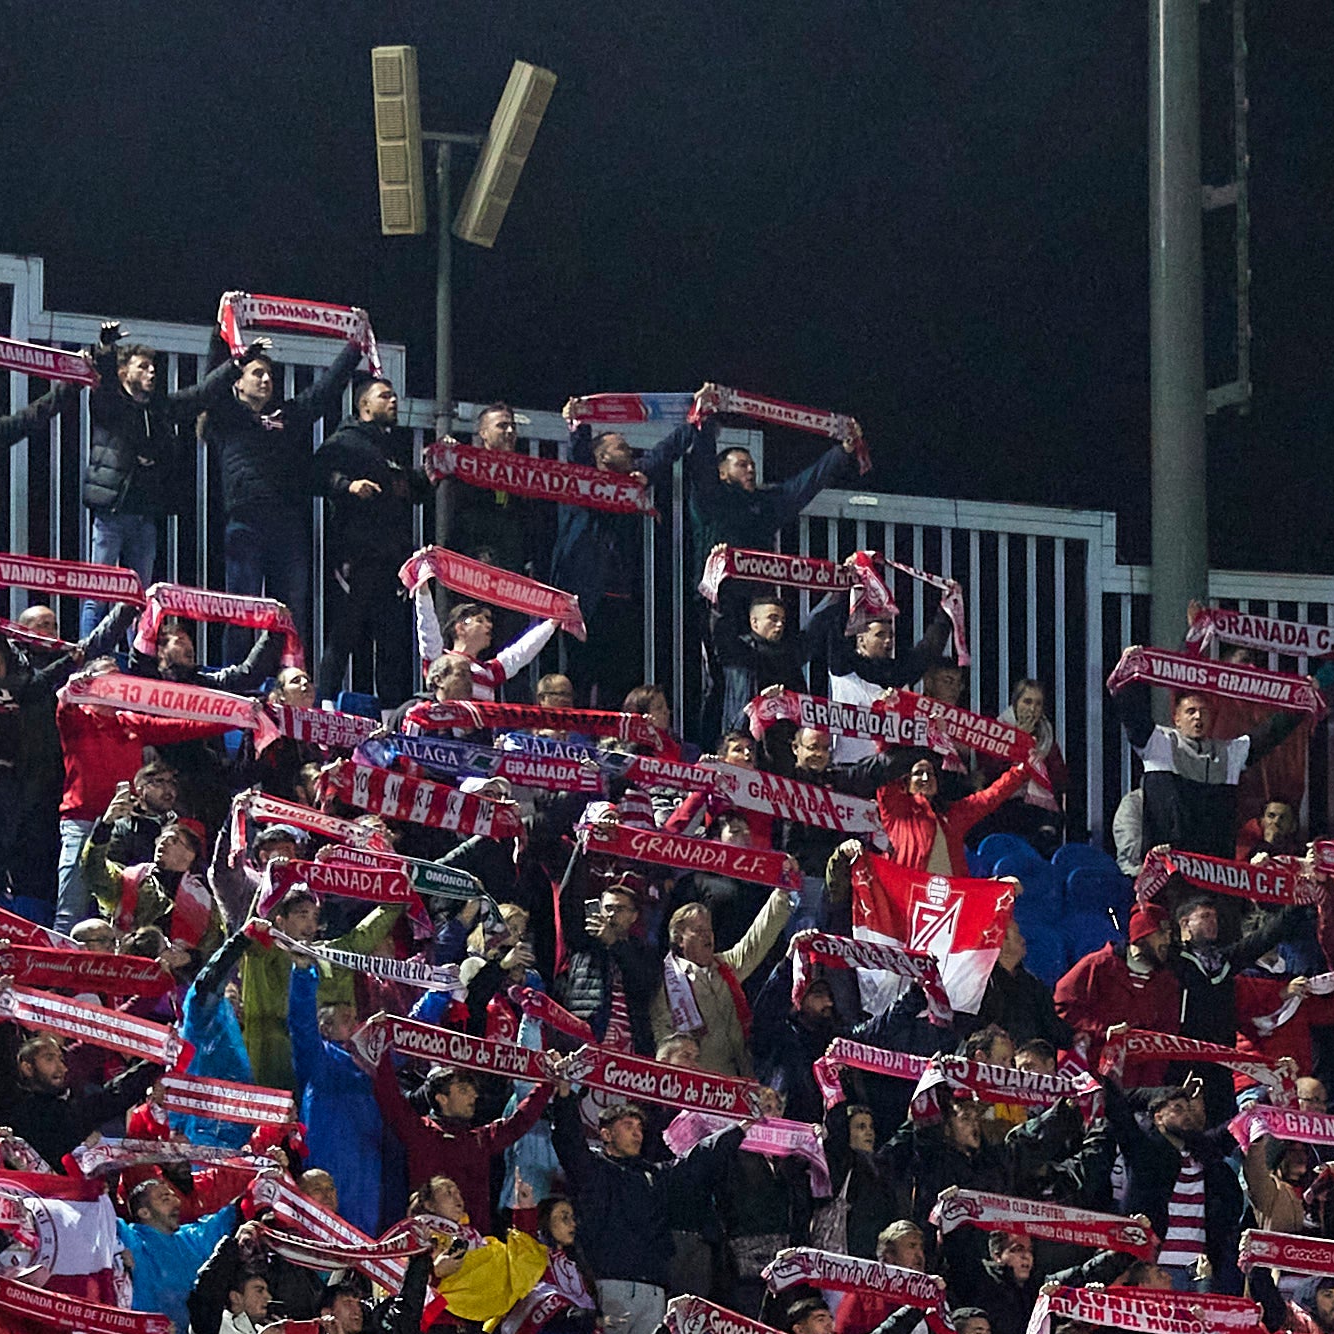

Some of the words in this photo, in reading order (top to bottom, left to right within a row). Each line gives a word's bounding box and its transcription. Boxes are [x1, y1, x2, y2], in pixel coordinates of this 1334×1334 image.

[257, 301, 320, 323] GRANADA
[733, 552, 787, 580] Granada
[791, 556, 813, 581] Club
[1214, 611, 1310, 651] GRANADA
[801, 696, 894, 736] GRANADA
[899, 721, 927, 747] CF
[915, 696, 1017, 745] GRANADA
[505, 758, 579, 781] GRANADA
[639, 758, 713, 783] GRANADA
[632, 832, 728, 868] GRANADA
[733, 853, 766, 874] C.F.
[310, 865, 380, 896] GRANADA
[393, 1022, 449, 1056] Granada
[450, 1034, 475, 1061] Club
[476, 1041, 492, 1066] de
[603, 1061, 656, 1096] Granada
[658, 1072, 682, 1101] Club
[684, 1080, 701, 1102] de
[1105, 1309, 1140, 1329] DEL
